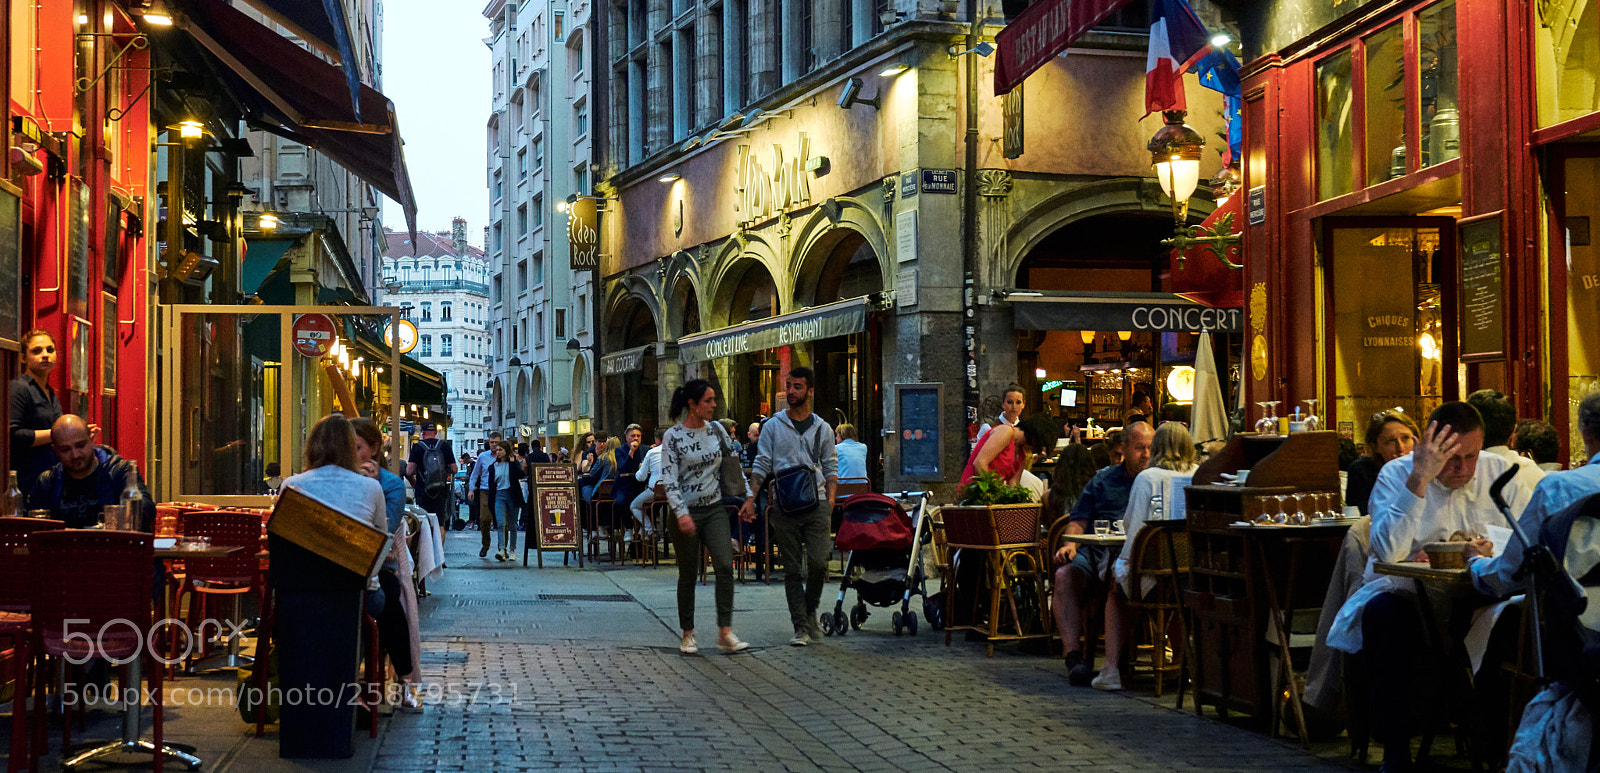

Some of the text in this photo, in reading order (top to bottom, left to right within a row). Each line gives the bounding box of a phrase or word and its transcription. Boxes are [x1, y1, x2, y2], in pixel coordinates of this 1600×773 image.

[933, 174, 948, 182] RUE
[931, 182, 955, 191] MONNAIE
[1132, 306, 1240, 330] CONCERT
[1367, 314, 1409, 328] CHIQUES
[706, 316, 823, 358] CONCERT LIVE RESTAURANT
[1363, 336, 1414, 347] LYONNAISES
